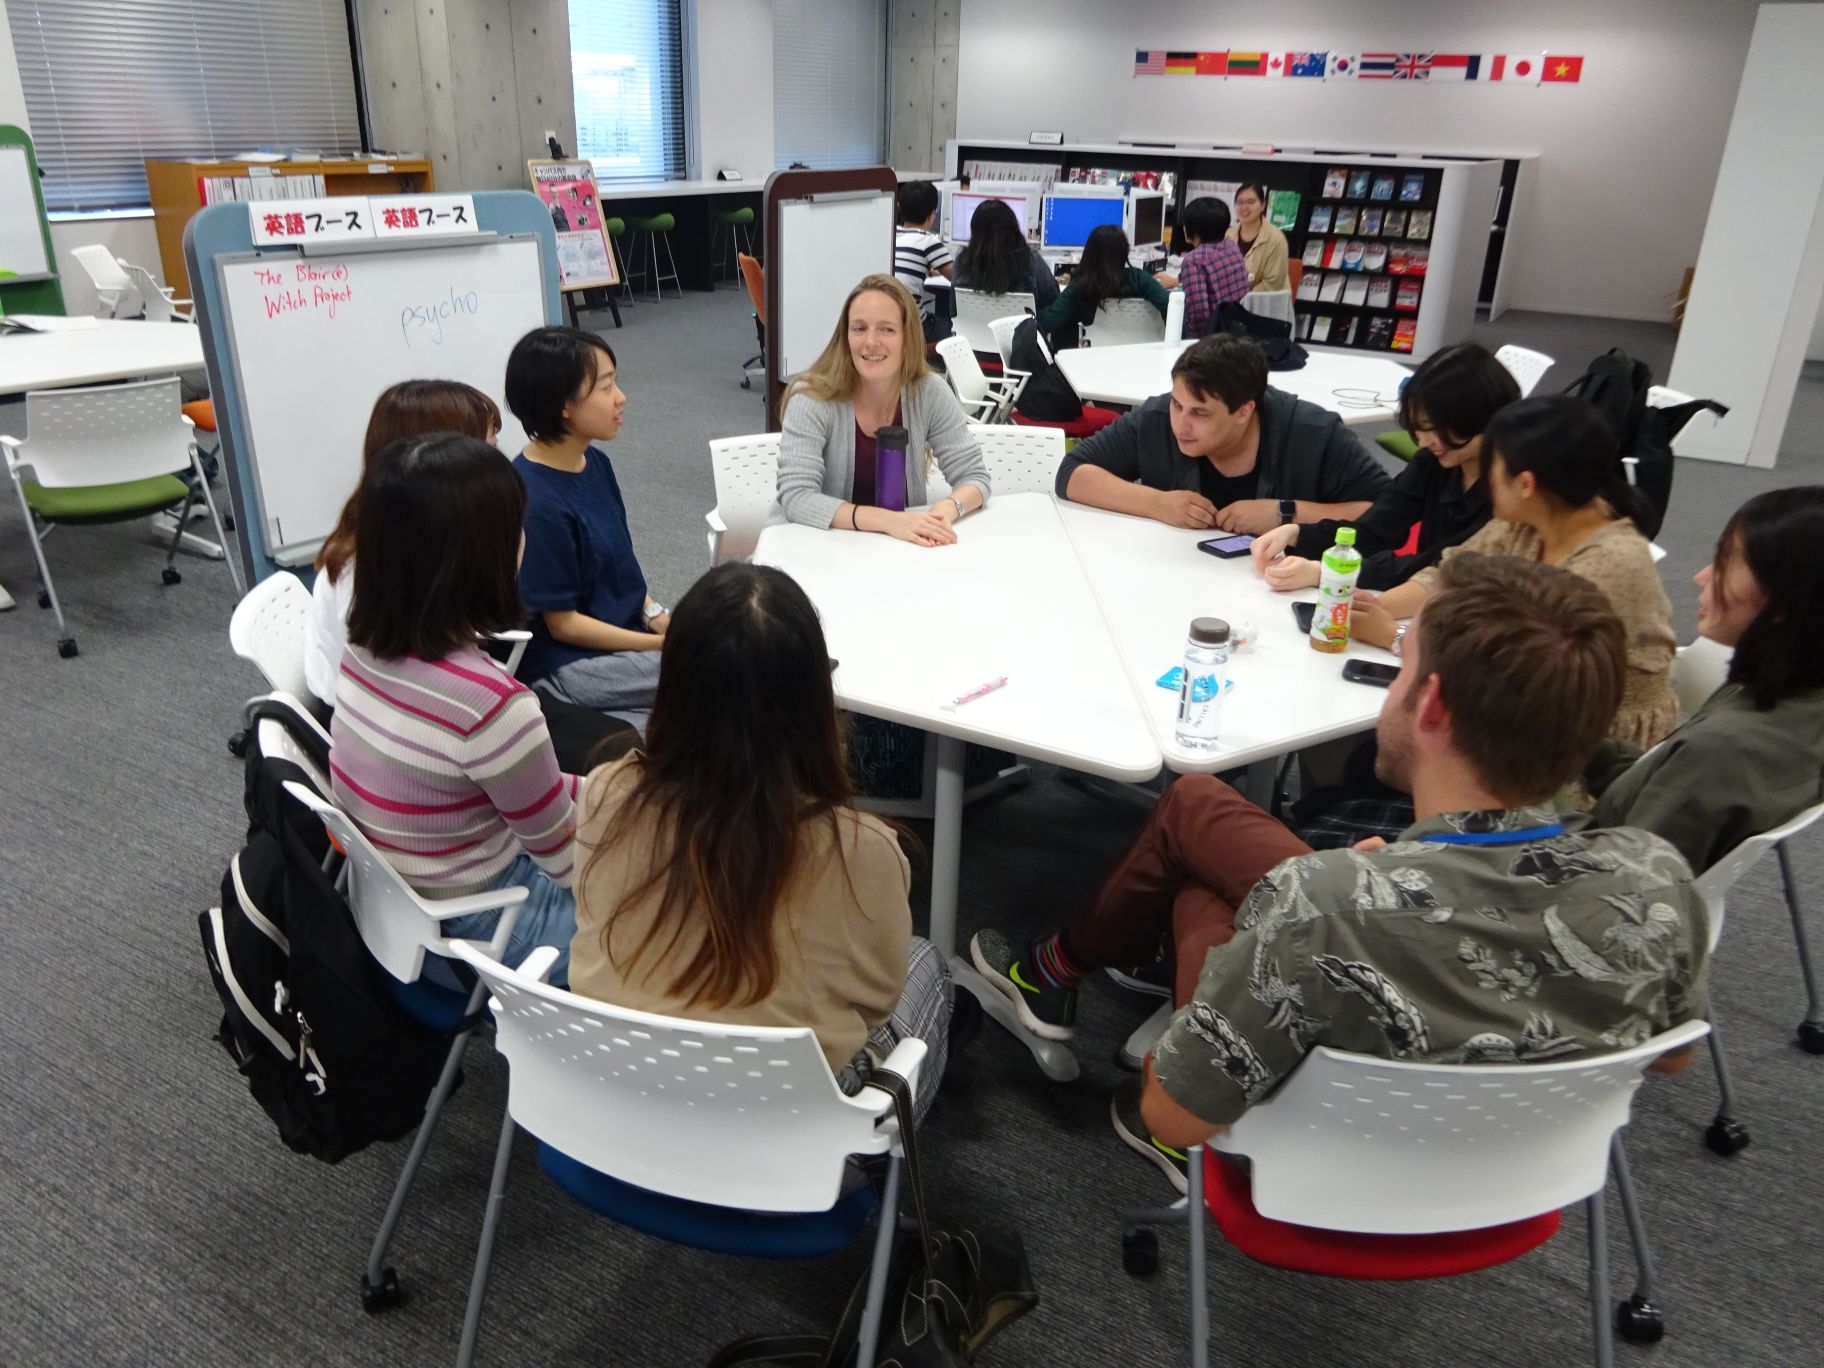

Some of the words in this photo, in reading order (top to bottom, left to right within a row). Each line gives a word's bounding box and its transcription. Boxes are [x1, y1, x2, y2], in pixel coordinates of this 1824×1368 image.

[263, 210, 363, 237] 英語ブース
[382, 205, 468, 230] 英語ブース
[254, 268, 282, 285] The
[264, 288, 307, 319] Witch
[314, 284, 352, 319] Project
[401, 285, 478, 349] psycho
